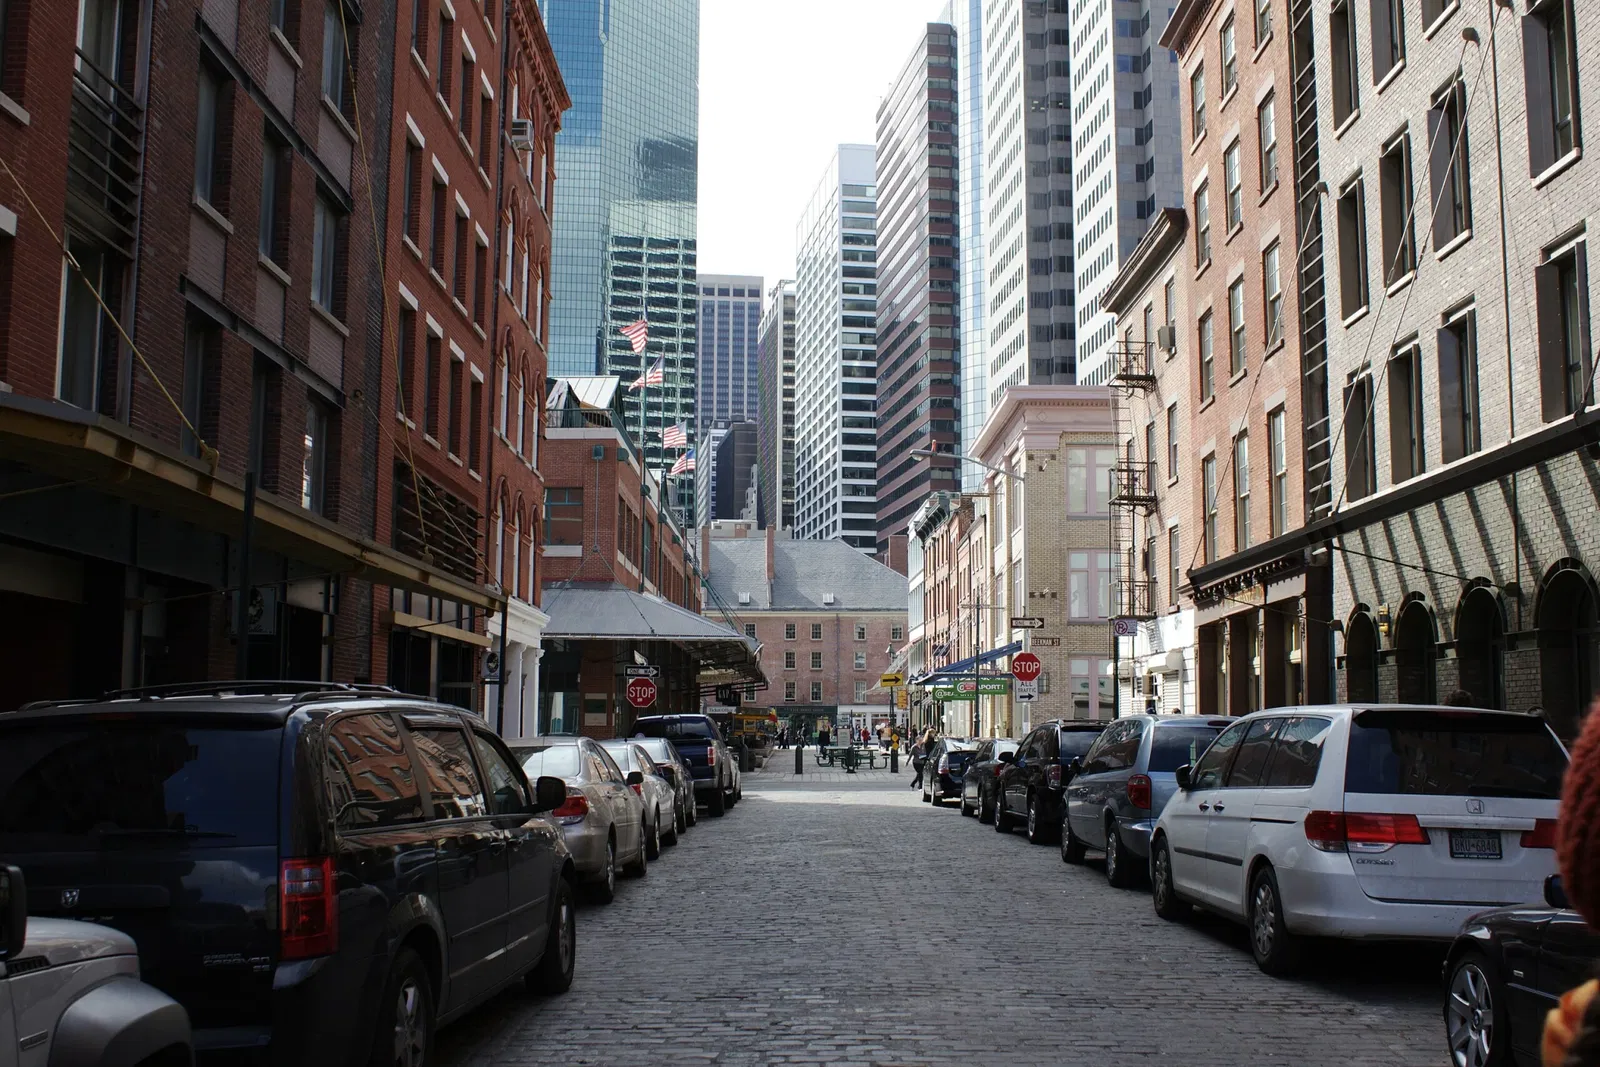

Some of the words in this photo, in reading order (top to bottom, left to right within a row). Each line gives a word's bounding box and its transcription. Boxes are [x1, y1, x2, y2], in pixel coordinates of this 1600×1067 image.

[1032, 638, 1053, 646] BEEKMAN
[1053, 638, 1060, 646] ST
[1013, 661, 1040, 673] STOP
[629, 686, 655, 698] STOP
[1356, 858, 1396, 866] ODYSSEY
